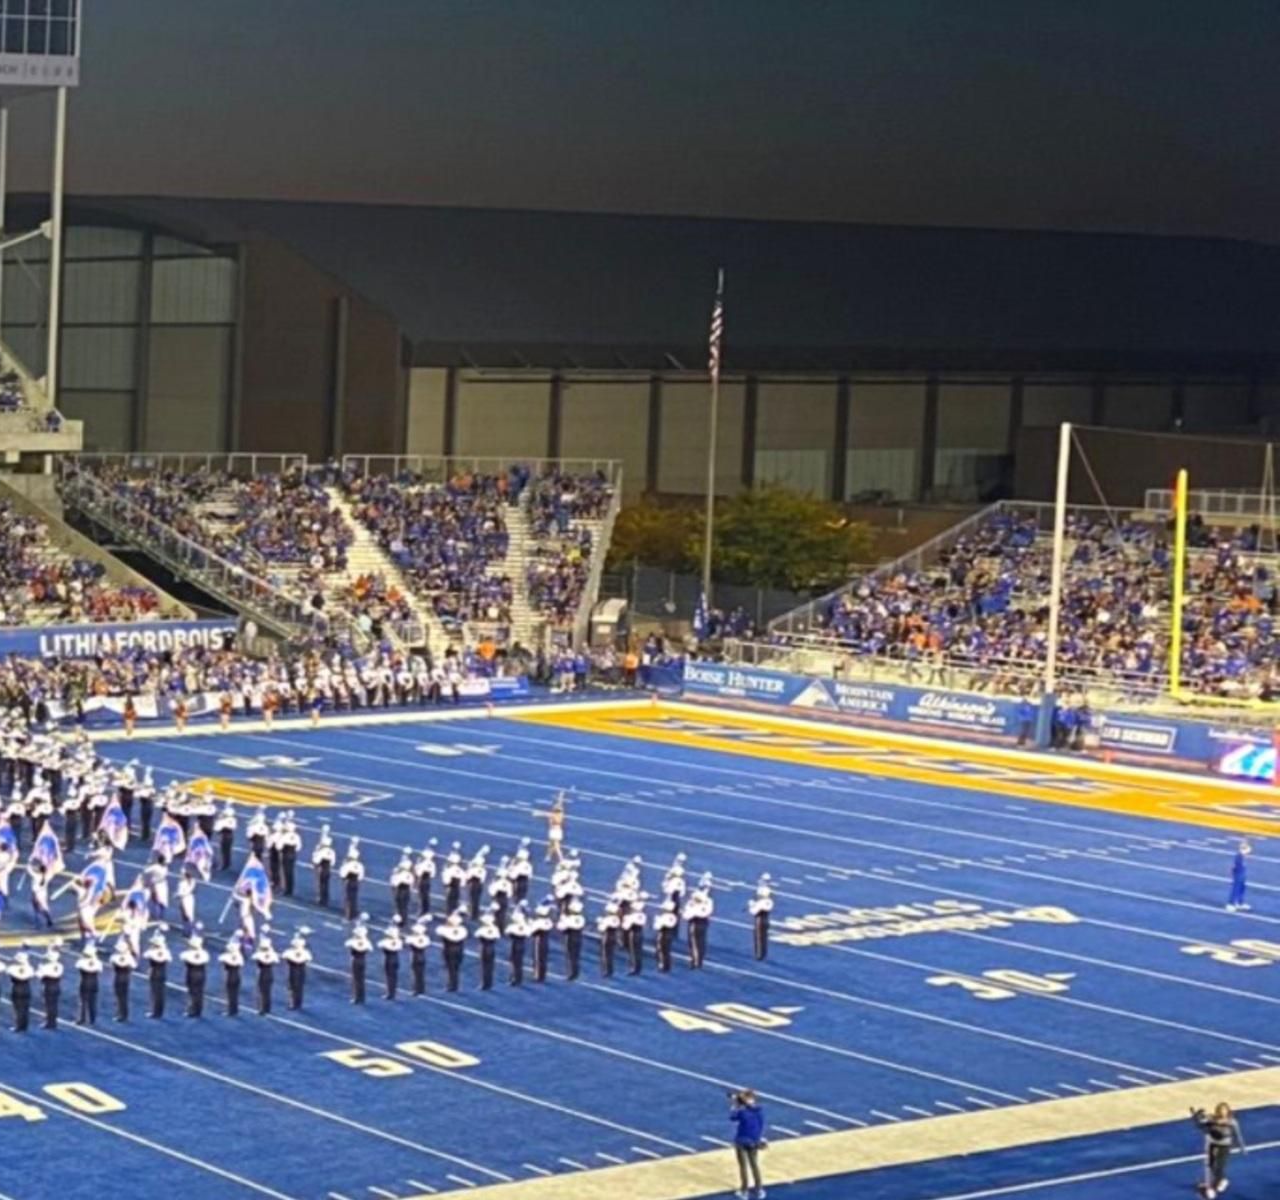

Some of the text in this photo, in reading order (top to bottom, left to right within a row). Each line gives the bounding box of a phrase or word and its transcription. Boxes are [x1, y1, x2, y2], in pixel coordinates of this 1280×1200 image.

[684, 665, 724, 682] BOISE
[728, 672, 785, 693] HUNTER
[835, 683, 894, 701] MOUNTAIN
[840, 697, 888, 712] AMERICA
[925, 960, 1070, 999] 30
[658, 1002, 793, 1034] 40
[325, 1040, 482, 1078] 50
